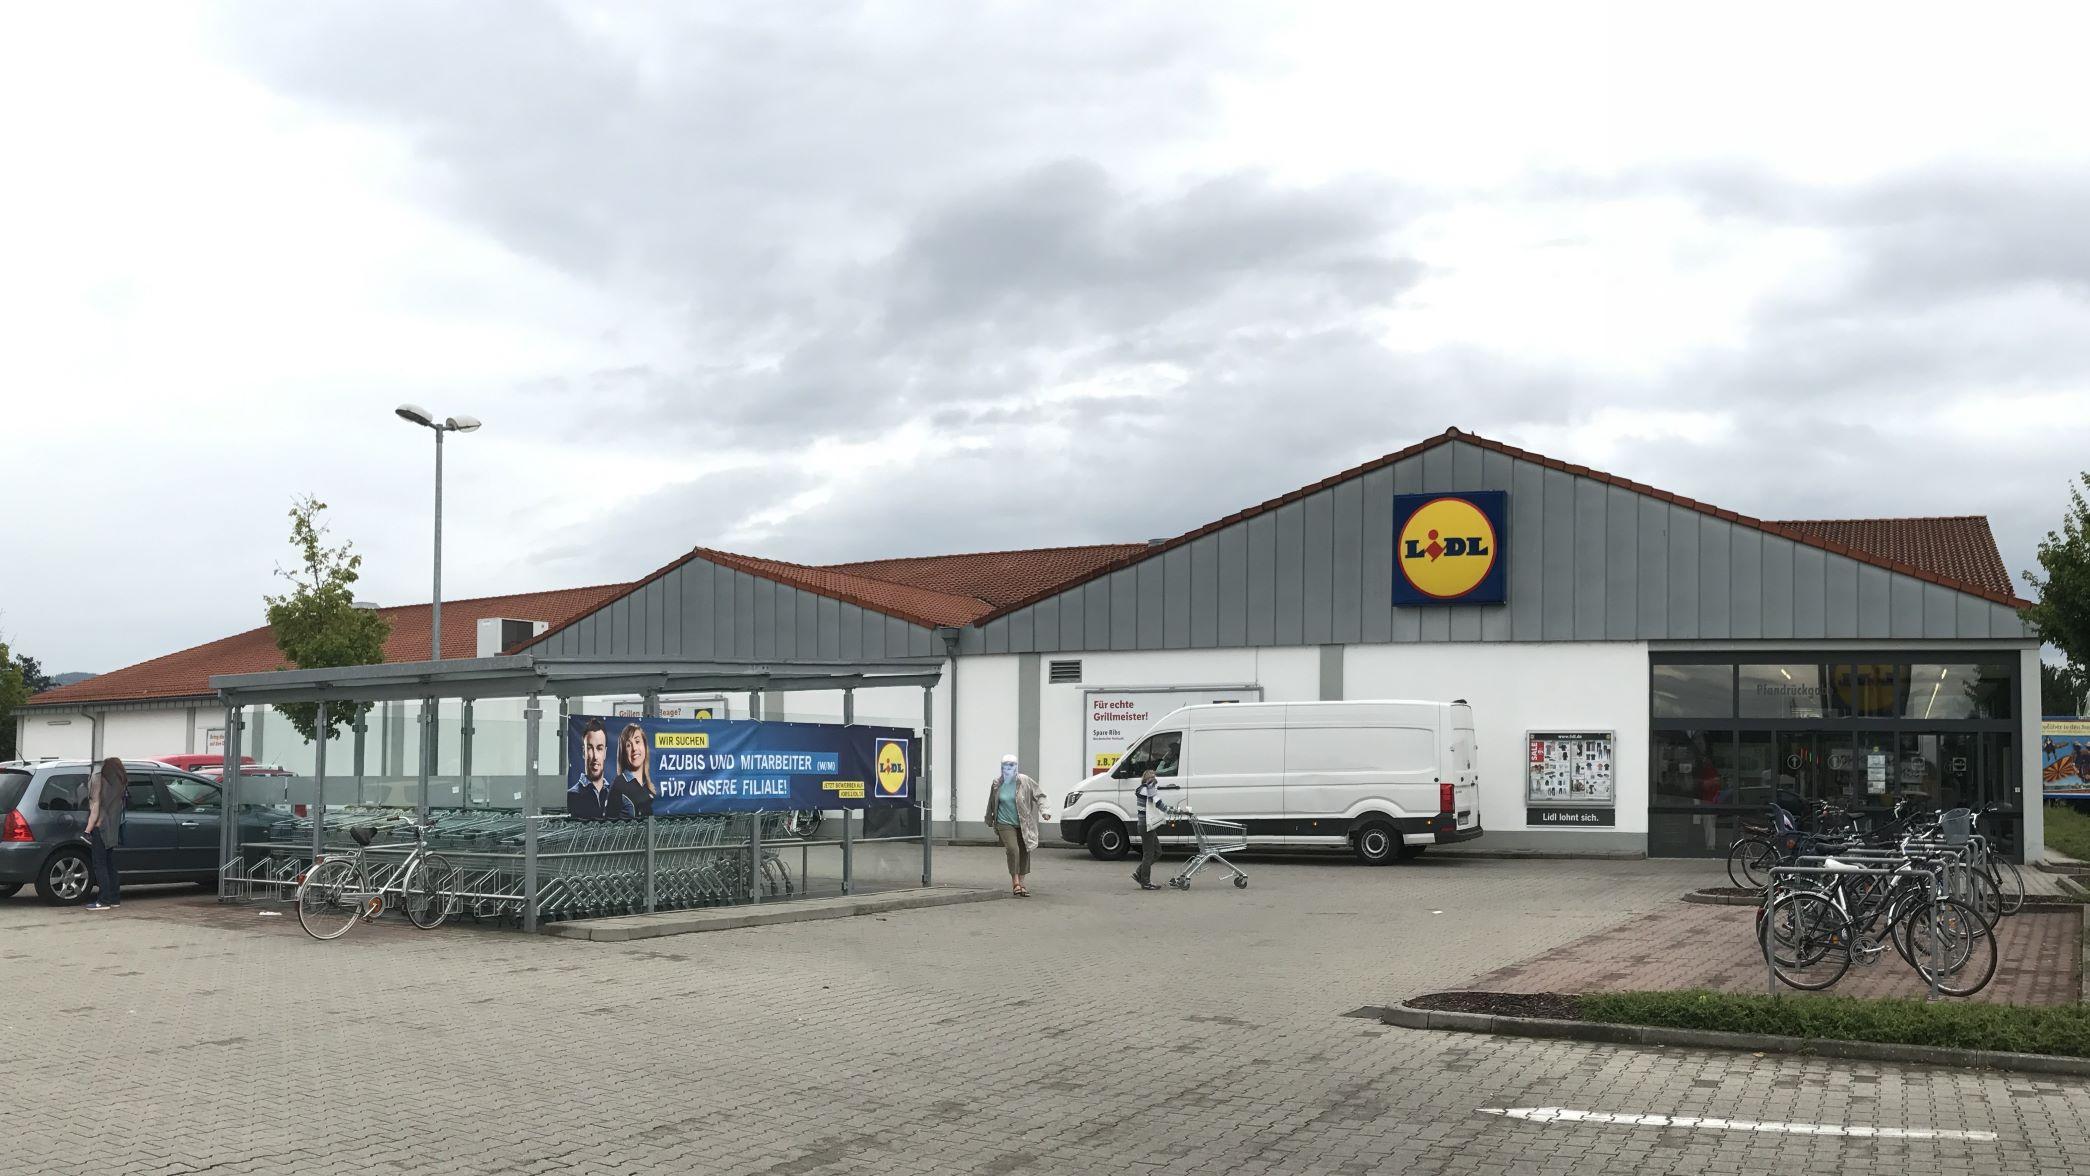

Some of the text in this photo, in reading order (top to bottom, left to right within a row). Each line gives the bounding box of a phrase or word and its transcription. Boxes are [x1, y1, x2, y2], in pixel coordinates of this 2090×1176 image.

[1405, 529, 1489, 563] LIDL
[1094, 700, 1134, 709] Für echte
[1093, 712, 1148, 721] Grillmeister!
[1093, 729, 1108, 737] Spare
[659, 735, 705, 746] WIR SUCHEN
[659, 754, 705, 771] AZUBIS
[710, 754, 735, 770] UND
[740, 754, 812, 770] MITARBEITER
[660, 777, 787, 797] FÜR UNSERE FILIALE!
[1543, 813, 1599, 822] Lidl lohnt sich.
